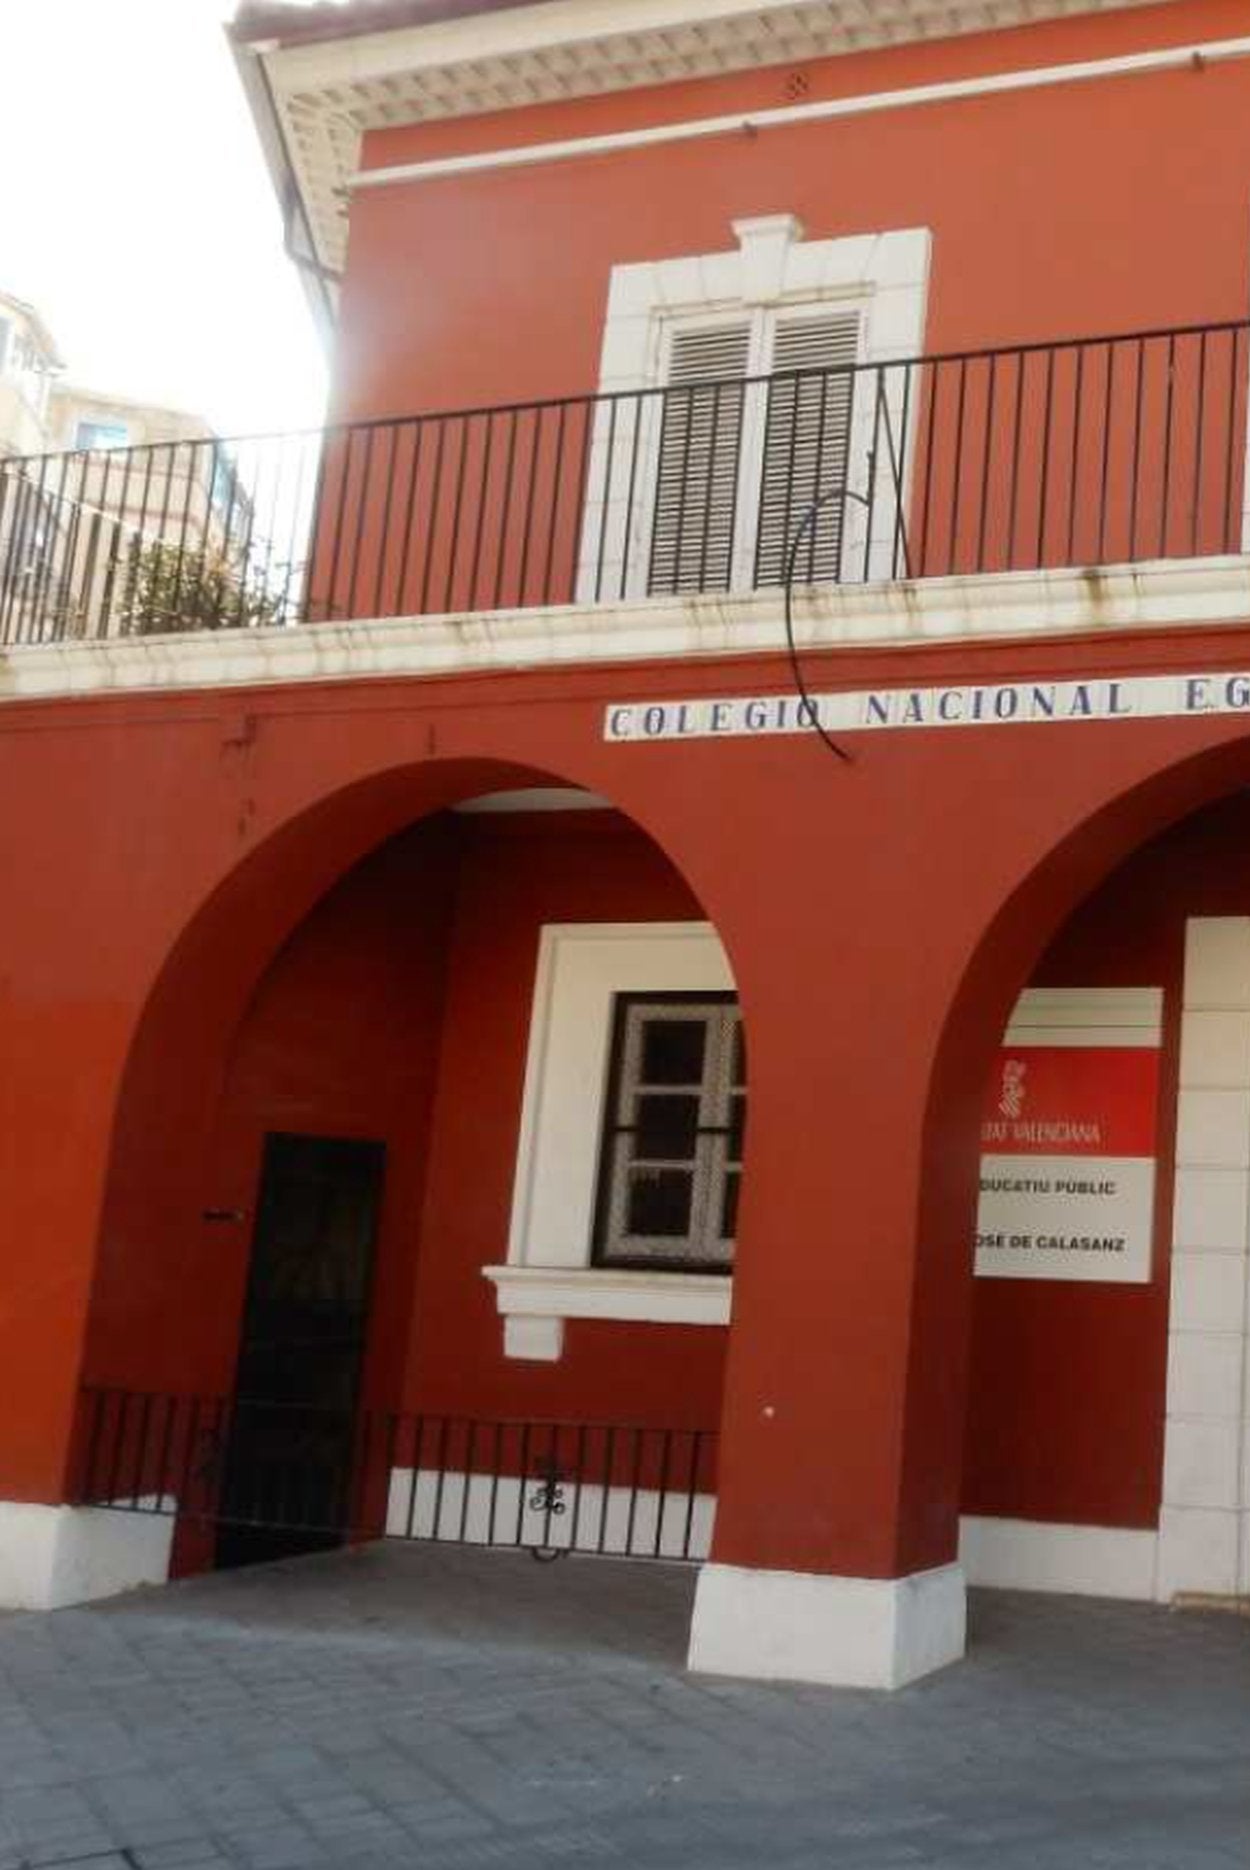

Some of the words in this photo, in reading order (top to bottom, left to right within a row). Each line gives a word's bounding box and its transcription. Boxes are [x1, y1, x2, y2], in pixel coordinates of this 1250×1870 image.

[611, 699, 819, 736] COLEGIO
[866, 683, 1133, 724] NACIONAL
[1008, 1234, 1033, 1249] DE
[1036, 1234, 1126, 1252] CALASANZ
